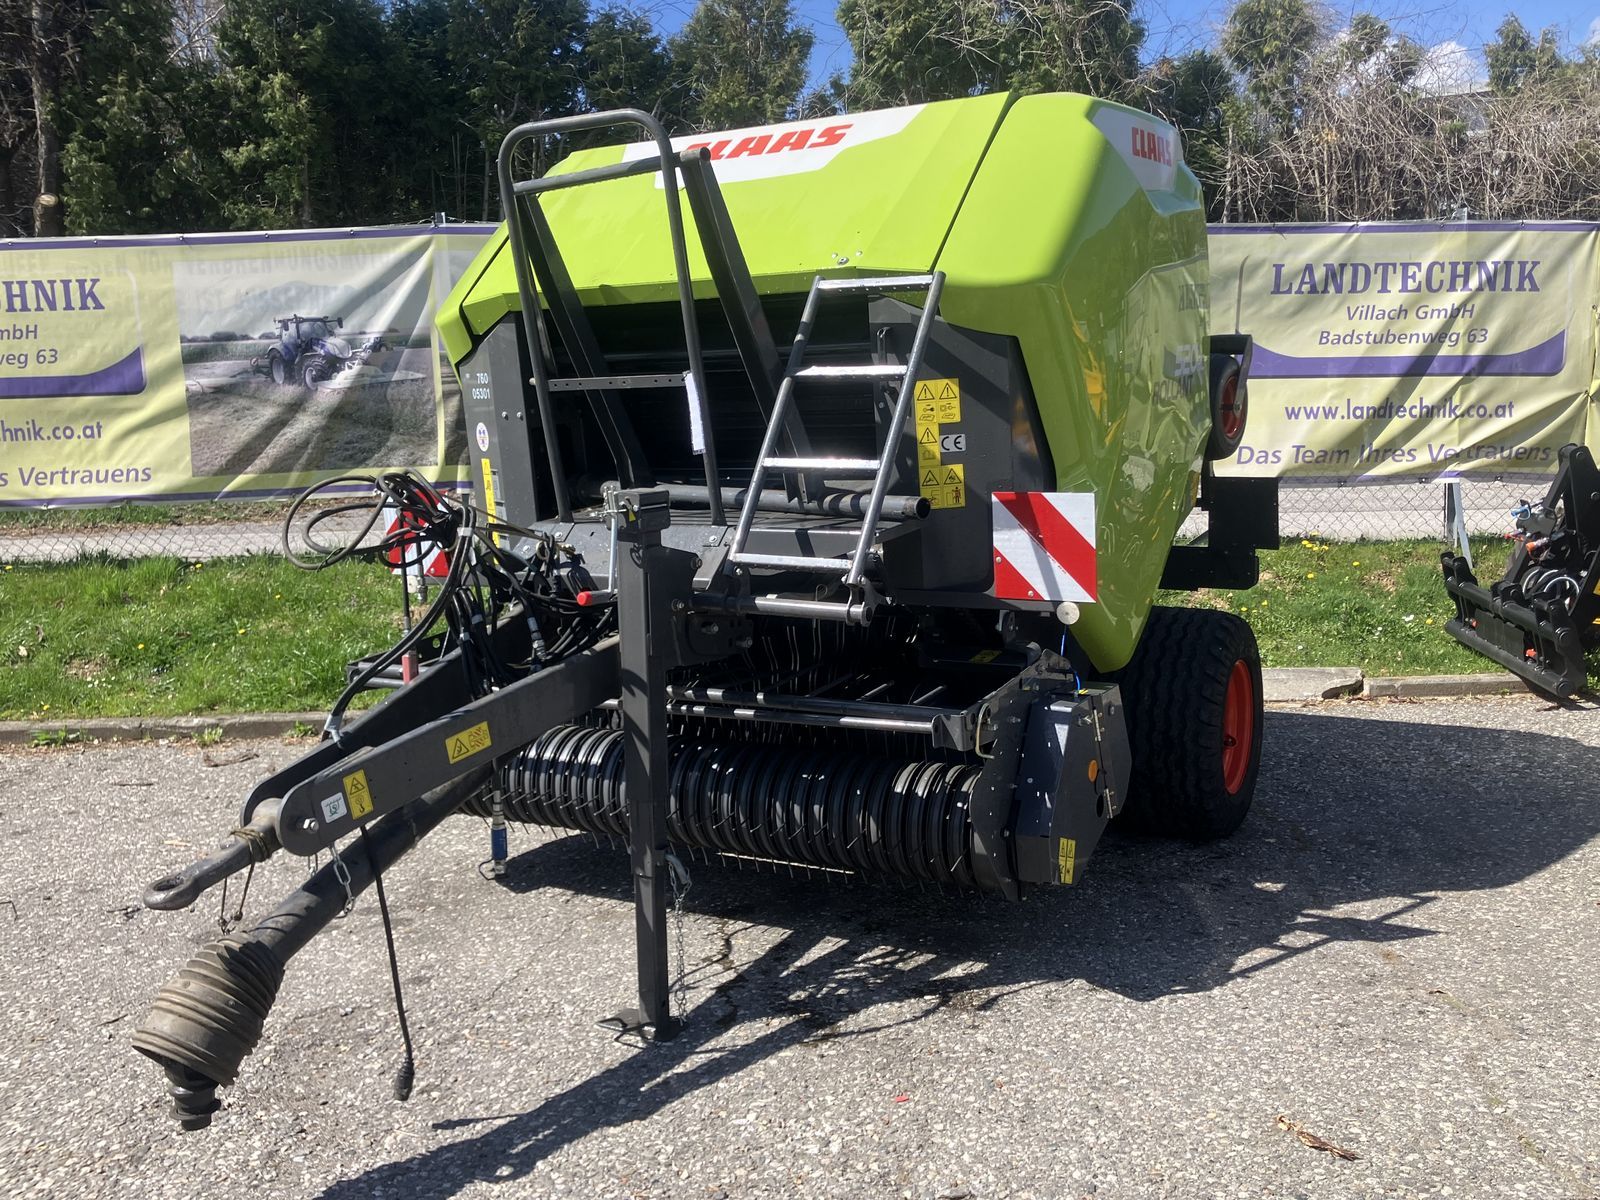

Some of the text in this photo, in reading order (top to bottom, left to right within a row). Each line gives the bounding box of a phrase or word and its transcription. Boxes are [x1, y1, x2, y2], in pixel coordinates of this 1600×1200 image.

[686, 124, 853, 161] LAAS
[1131, 127, 1172, 167] CLAAS
[1270, 260, 1540, 295] LANDTECHNIK
[0, 278, 105, 313] HNIK
[1346, 303, 1476, 322] Villach GmbH
[1318, 328, 1489, 347] Badstubenweg 63
[0, 348, 58, 369] eg 63
[476, 373, 489, 385] 760
[472, 388, 491, 400] 05301
[1285, 398, 1515, 422] www.landtechnik.co.at
[0, 419, 103, 442] hnik.co.at
[1236, 442, 1551, 465] Das Team Ihres Vertrauens
[18, 466, 152, 487] Vertrauens
